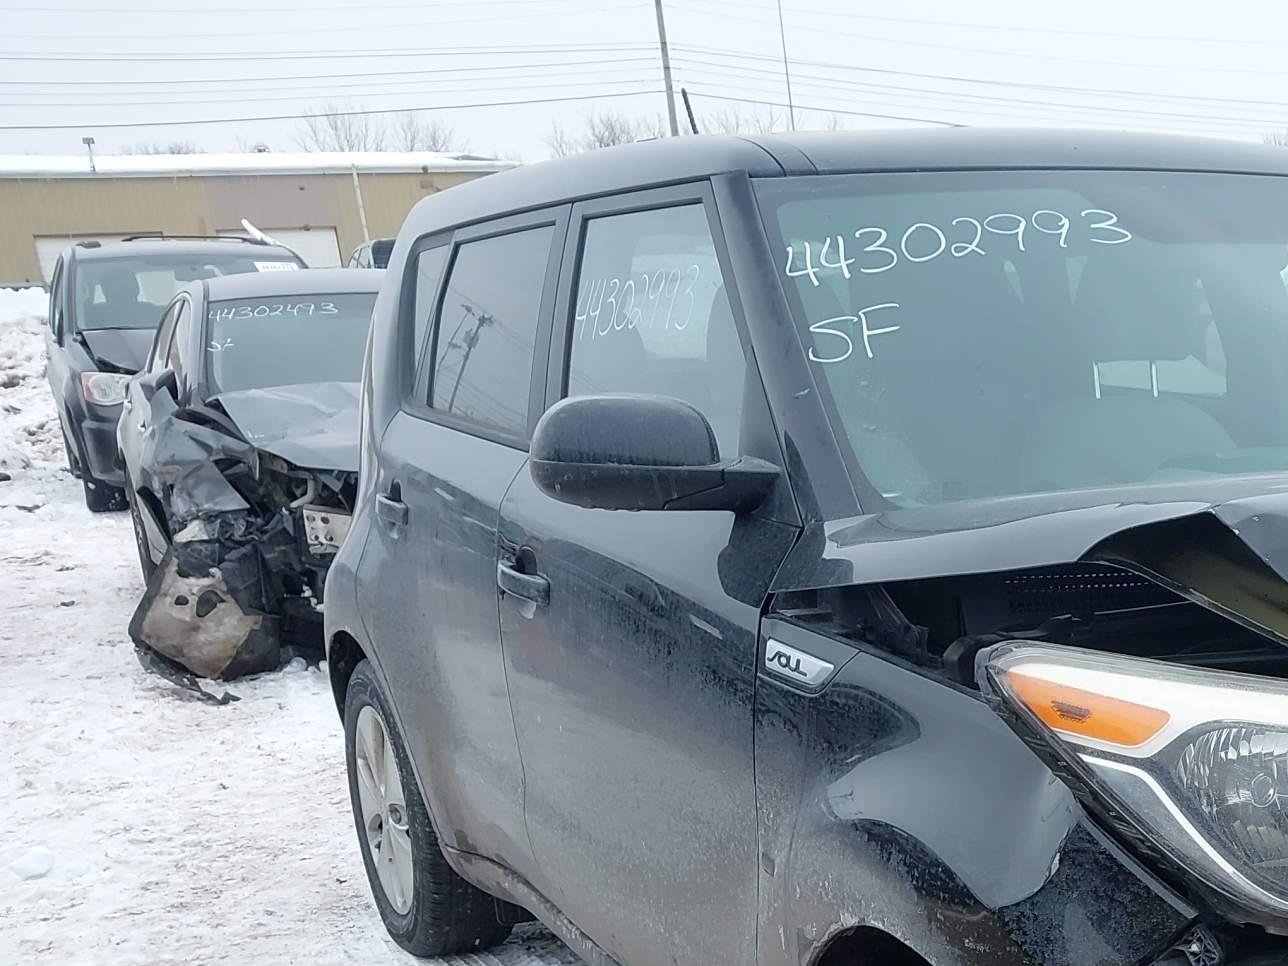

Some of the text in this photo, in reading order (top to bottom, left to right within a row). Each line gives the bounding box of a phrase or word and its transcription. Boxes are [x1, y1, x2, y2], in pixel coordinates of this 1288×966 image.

[785, 209, 1133, 286] 44302993
[576, 264, 700, 341] 44302993
[807, 303, 901, 363] SF
